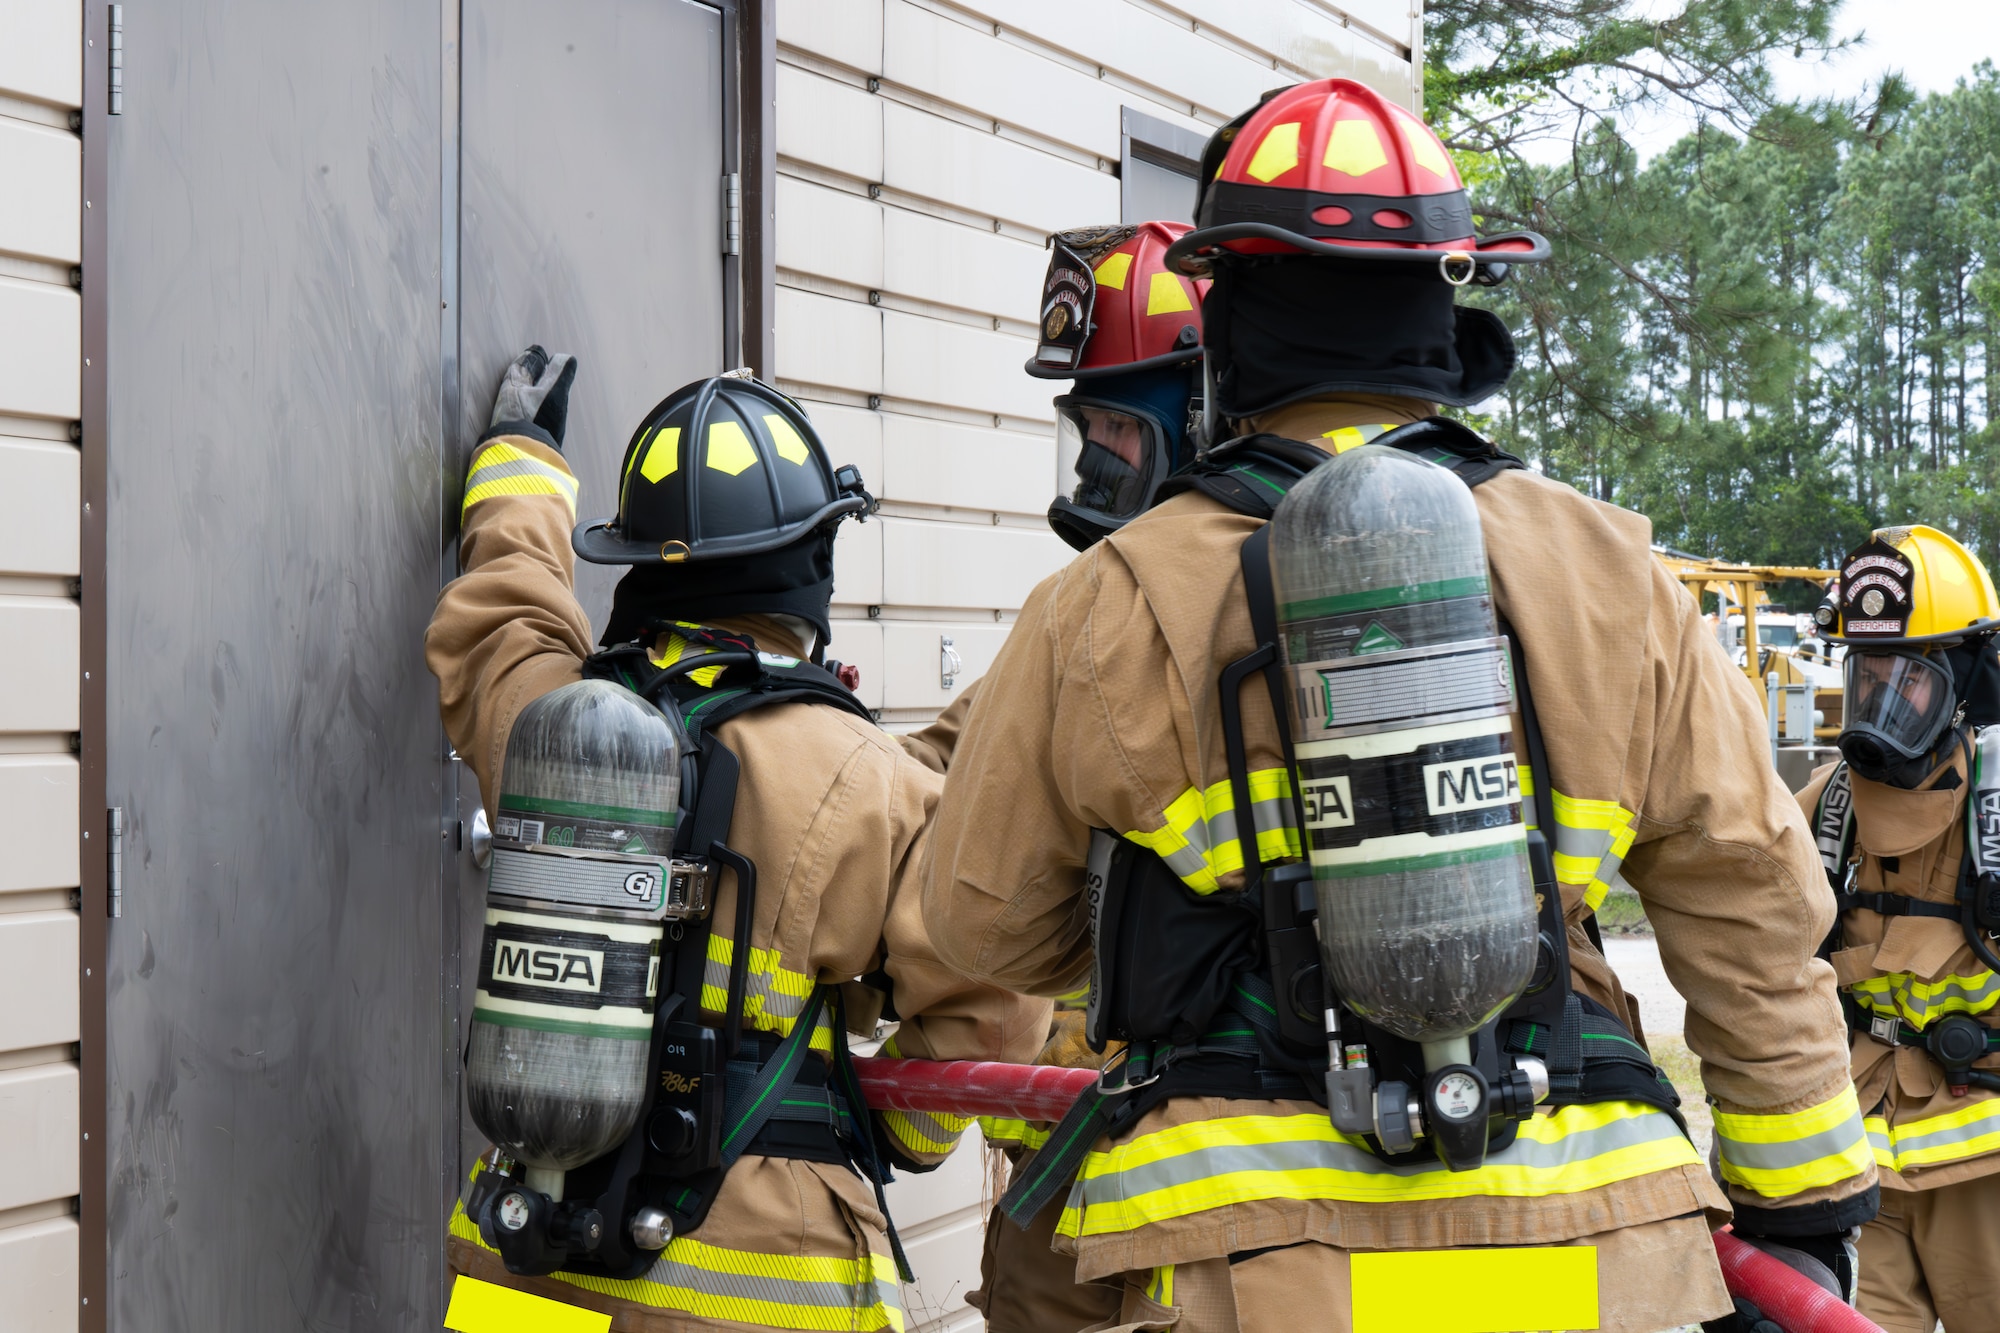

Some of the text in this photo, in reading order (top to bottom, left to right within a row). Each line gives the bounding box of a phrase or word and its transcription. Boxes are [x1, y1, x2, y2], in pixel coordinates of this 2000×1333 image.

[1847, 556, 1905, 577] HURLBURT FIELD
[1848, 574, 1905, 599] FIRE RESCUE
[1849, 621, 1901, 631] FIREFIGHTER
[1303, 784, 1349, 822] SA
[1821, 765, 1851, 837] MSA
[497, 945, 596, 987] MSA
